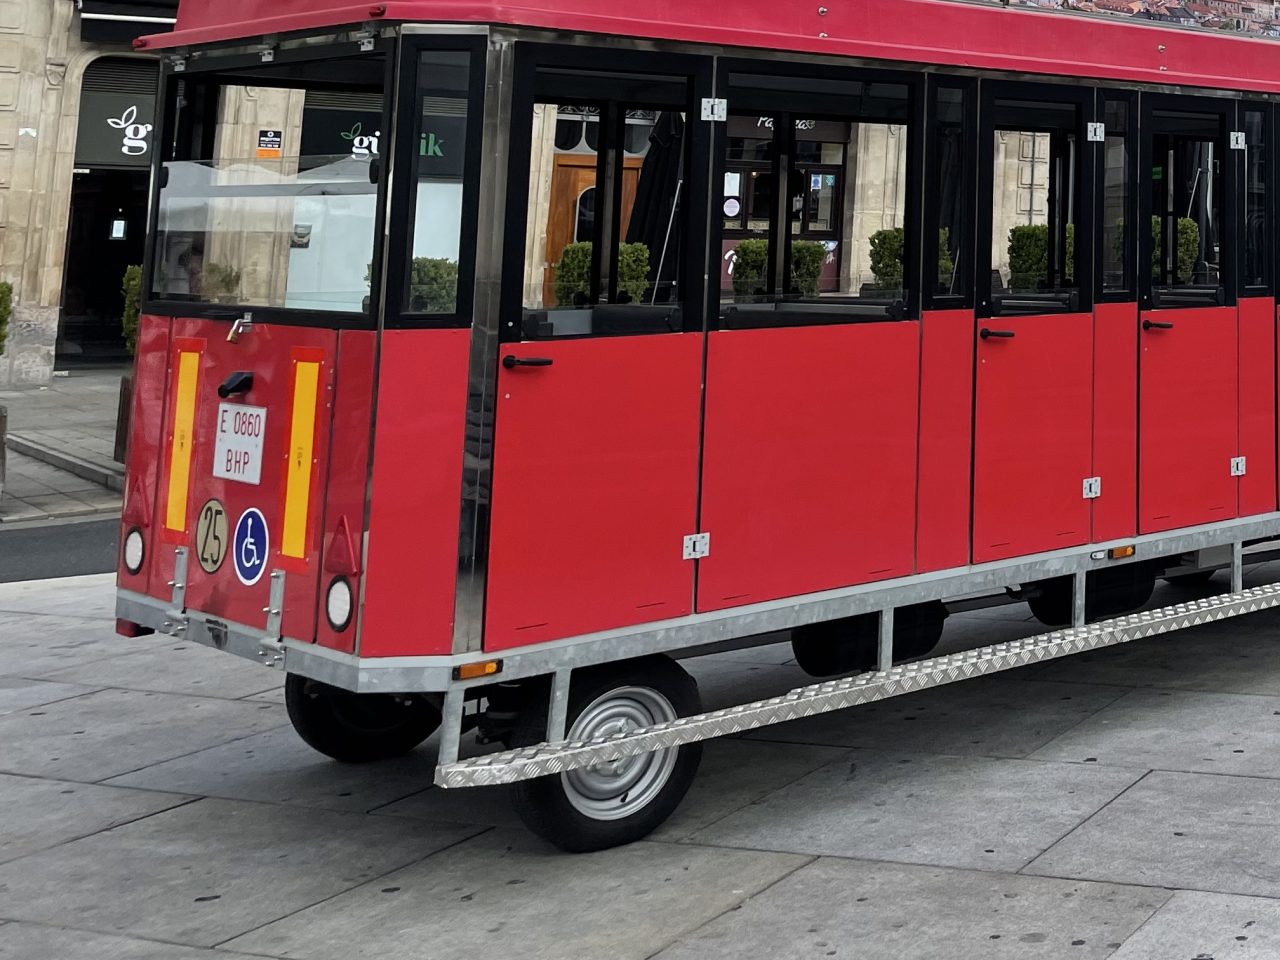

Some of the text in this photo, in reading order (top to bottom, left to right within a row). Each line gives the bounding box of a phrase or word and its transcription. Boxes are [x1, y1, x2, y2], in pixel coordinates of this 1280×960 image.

[220, 409, 261, 438] E 0860
[225, 449, 250, 475] BHP
[201, 506, 223, 566] 25
